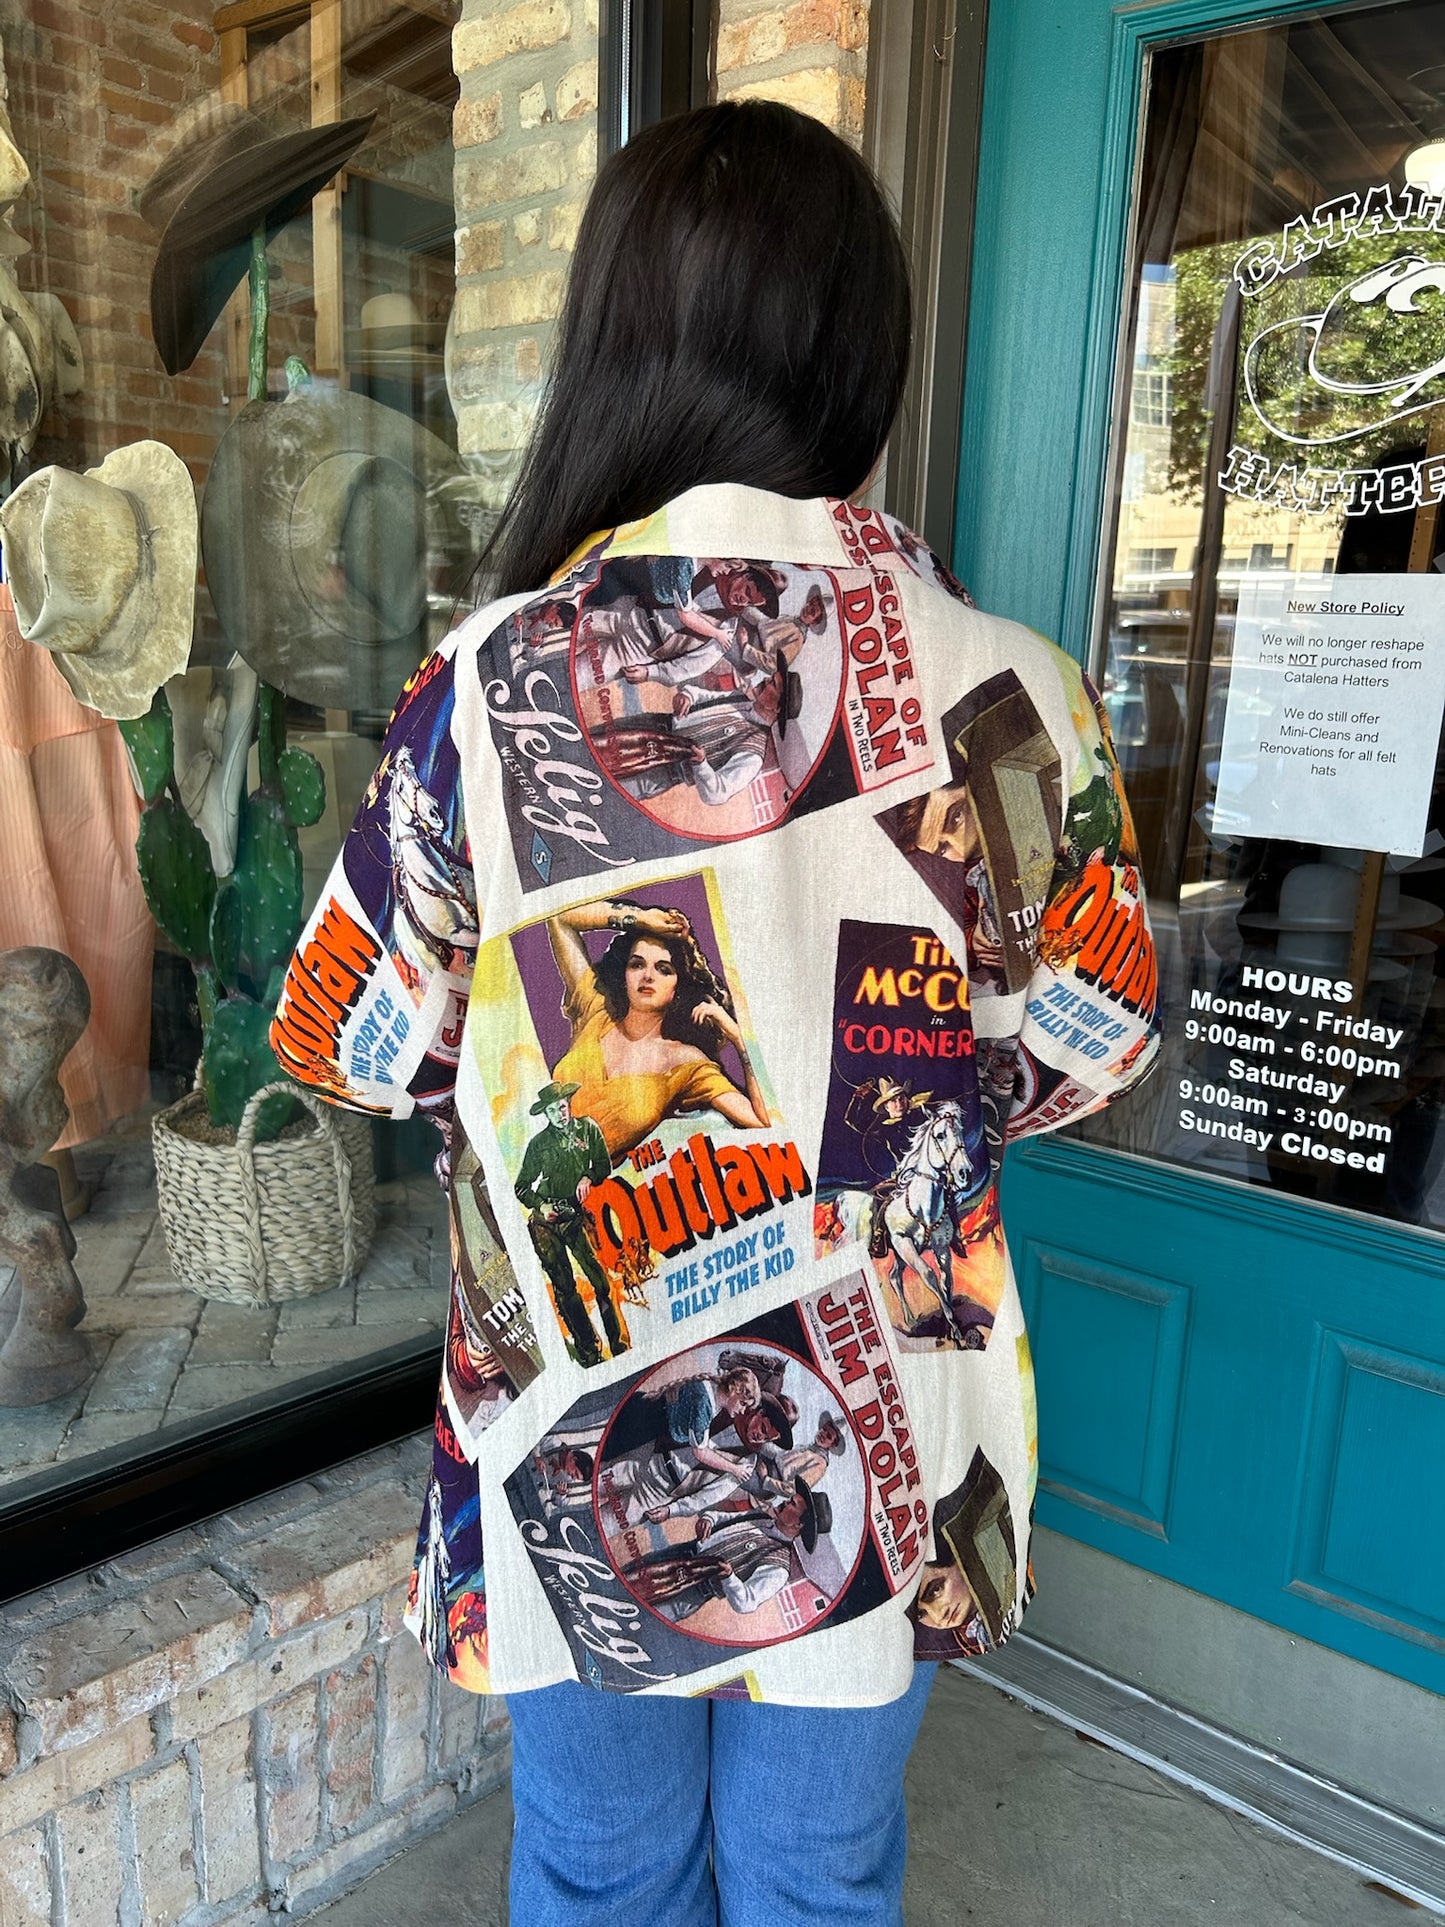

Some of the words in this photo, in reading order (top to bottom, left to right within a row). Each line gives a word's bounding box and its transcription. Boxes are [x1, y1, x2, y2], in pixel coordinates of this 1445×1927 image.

[1233, 183, 1445, 296] CATAL
[1287, 600, 1316, 614] New
[1320, 601, 1357, 614] Store
[1361, 602, 1405, 617] Policy
[871, 567, 914, 685] SCAPE
[900, 697, 928, 747] OF
[1259, 652, 1284, 664] hats
[1288, 653, 1318, 666] NOT
[1321, 656, 1388, 669] purchased
[1392, 657, 1422, 670] from
[1262, 634, 1282, 646] We
[1286, 635, 1305, 647] will
[1308, 637, 1324, 648] no
[1327, 636, 1367, 651] longer
[1370, 638, 1424, 652] reshape
[843, 584, 907, 771] DOLAN
[1284, 671, 1338, 685] Catalena
[1342, 674, 1390, 688] Hatters
[848, 699, 859, 712] IN
[851, 712, 867, 738] TWO
[1284, 707, 1304, 720] We
[1308, 709, 1324, 721] do
[1327, 711, 1348, 723] still
[1351, 712, 1380, 725] offer
[857, 737, 874, 773] REELS
[1259, 742, 1334, 759] Renovations
[1338, 747, 1355, 760] for
[1358, 750, 1373, 762] all
[1376, 751, 1397, 764] felt
[1280, 725, 1351, 741] Mini-Cleans
[1354, 732, 1379, 743] and
[484, 670, 637, 867] Selig
[500, 746, 542, 805] WESTERN
[1311, 764, 1337, 777] hats
[1242, 966, 1353, 1003] HOURS
[391, 1010, 410, 1044] KID
[930, 1015, 946, 1026] in
[1025, 999, 1073, 1039] BILLY
[1063, 1027, 1090, 1049] THE
[1079, 1038, 1111, 1060] KID
[1042, 982, 1081, 1012] THE
[1071, 1001, 1111, 1031] STORY
[1103, 1022, 1129, 1041] OF
[1190, 989, 1292, 1030] Monday
[1316, 1010, 1404, 1050] Friday
[351, 1054, 372, 1081] THE
[374, 988, 394, 1020] OF
[1185, 1020, 1275, 1055] 9:00am
[1301, 1040, 1400, 1079] 6:00pm
[1227, 1058, 1346, 1105] Saturday
[1179, 1079, 1269, 1117] 9:00am
[1293, 1106, 1392, 1143] 3:00pm
[628, 1138, 666, 1172] THE
[1179, 1109, 1274, 1152] Sunday
[1280, 1132, 1386, 1174] Closed
[583, 1132, 812, 1273] Outlaw
[665, 1262, 699, 1298] THE
[703, 1231, 759, 1280] STORY
[762, 1220, 785, 1251] OF
[671, 1281, 721, 1324] BILLY
[726, 1263, 760, 1298] THE
[764, 1247, 795, 1281] KID
[482, 1287, 526, 1331] TOM
[501, 1322, 527, 1348] THE
[817, 1291, 870, 1388] JIM
[853, 1398, 920, 1572] DOLAN
[848, 1287, 882, 1354] THE
[873, 1362, 921, 1492] ESCAPE
[913, 1499, 929, 1540] OF
[874, 1511, 884, 1525] IN
[878, 1524, 892, 1546] TWO
[886, 1545, 901, 1576] REELS
[519, 1517, 679, 1681] Selig
[543, 1573, 589, 1628] WESTERN
